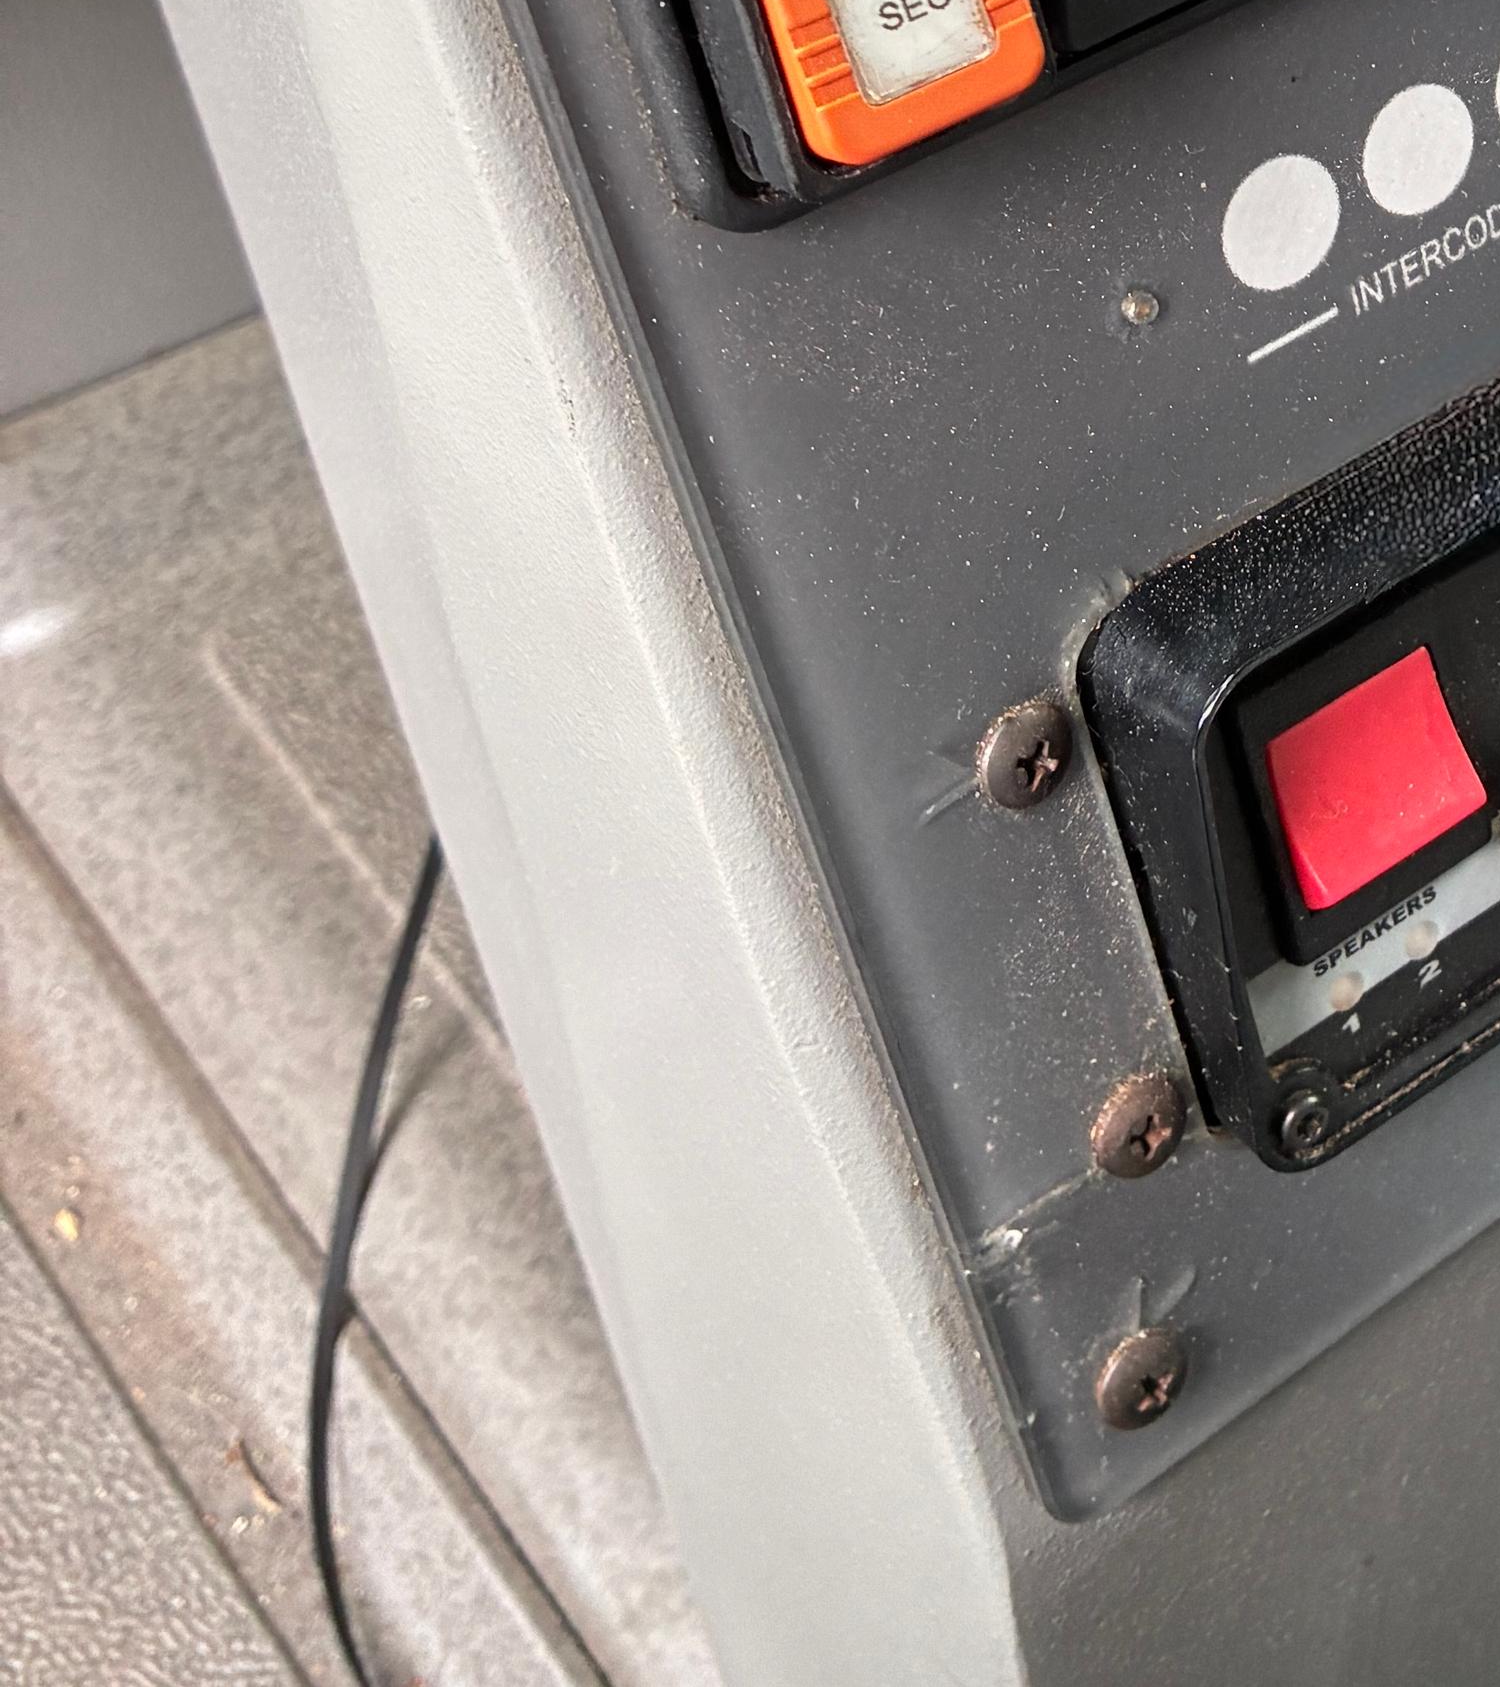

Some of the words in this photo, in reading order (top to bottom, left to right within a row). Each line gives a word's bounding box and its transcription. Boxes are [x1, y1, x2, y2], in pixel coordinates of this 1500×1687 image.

[1312, 884, 1438, 980] SPEAKERS
[1418, 959, 1442, 988] 2
[1341, 1013, 1360, 1033] 1
